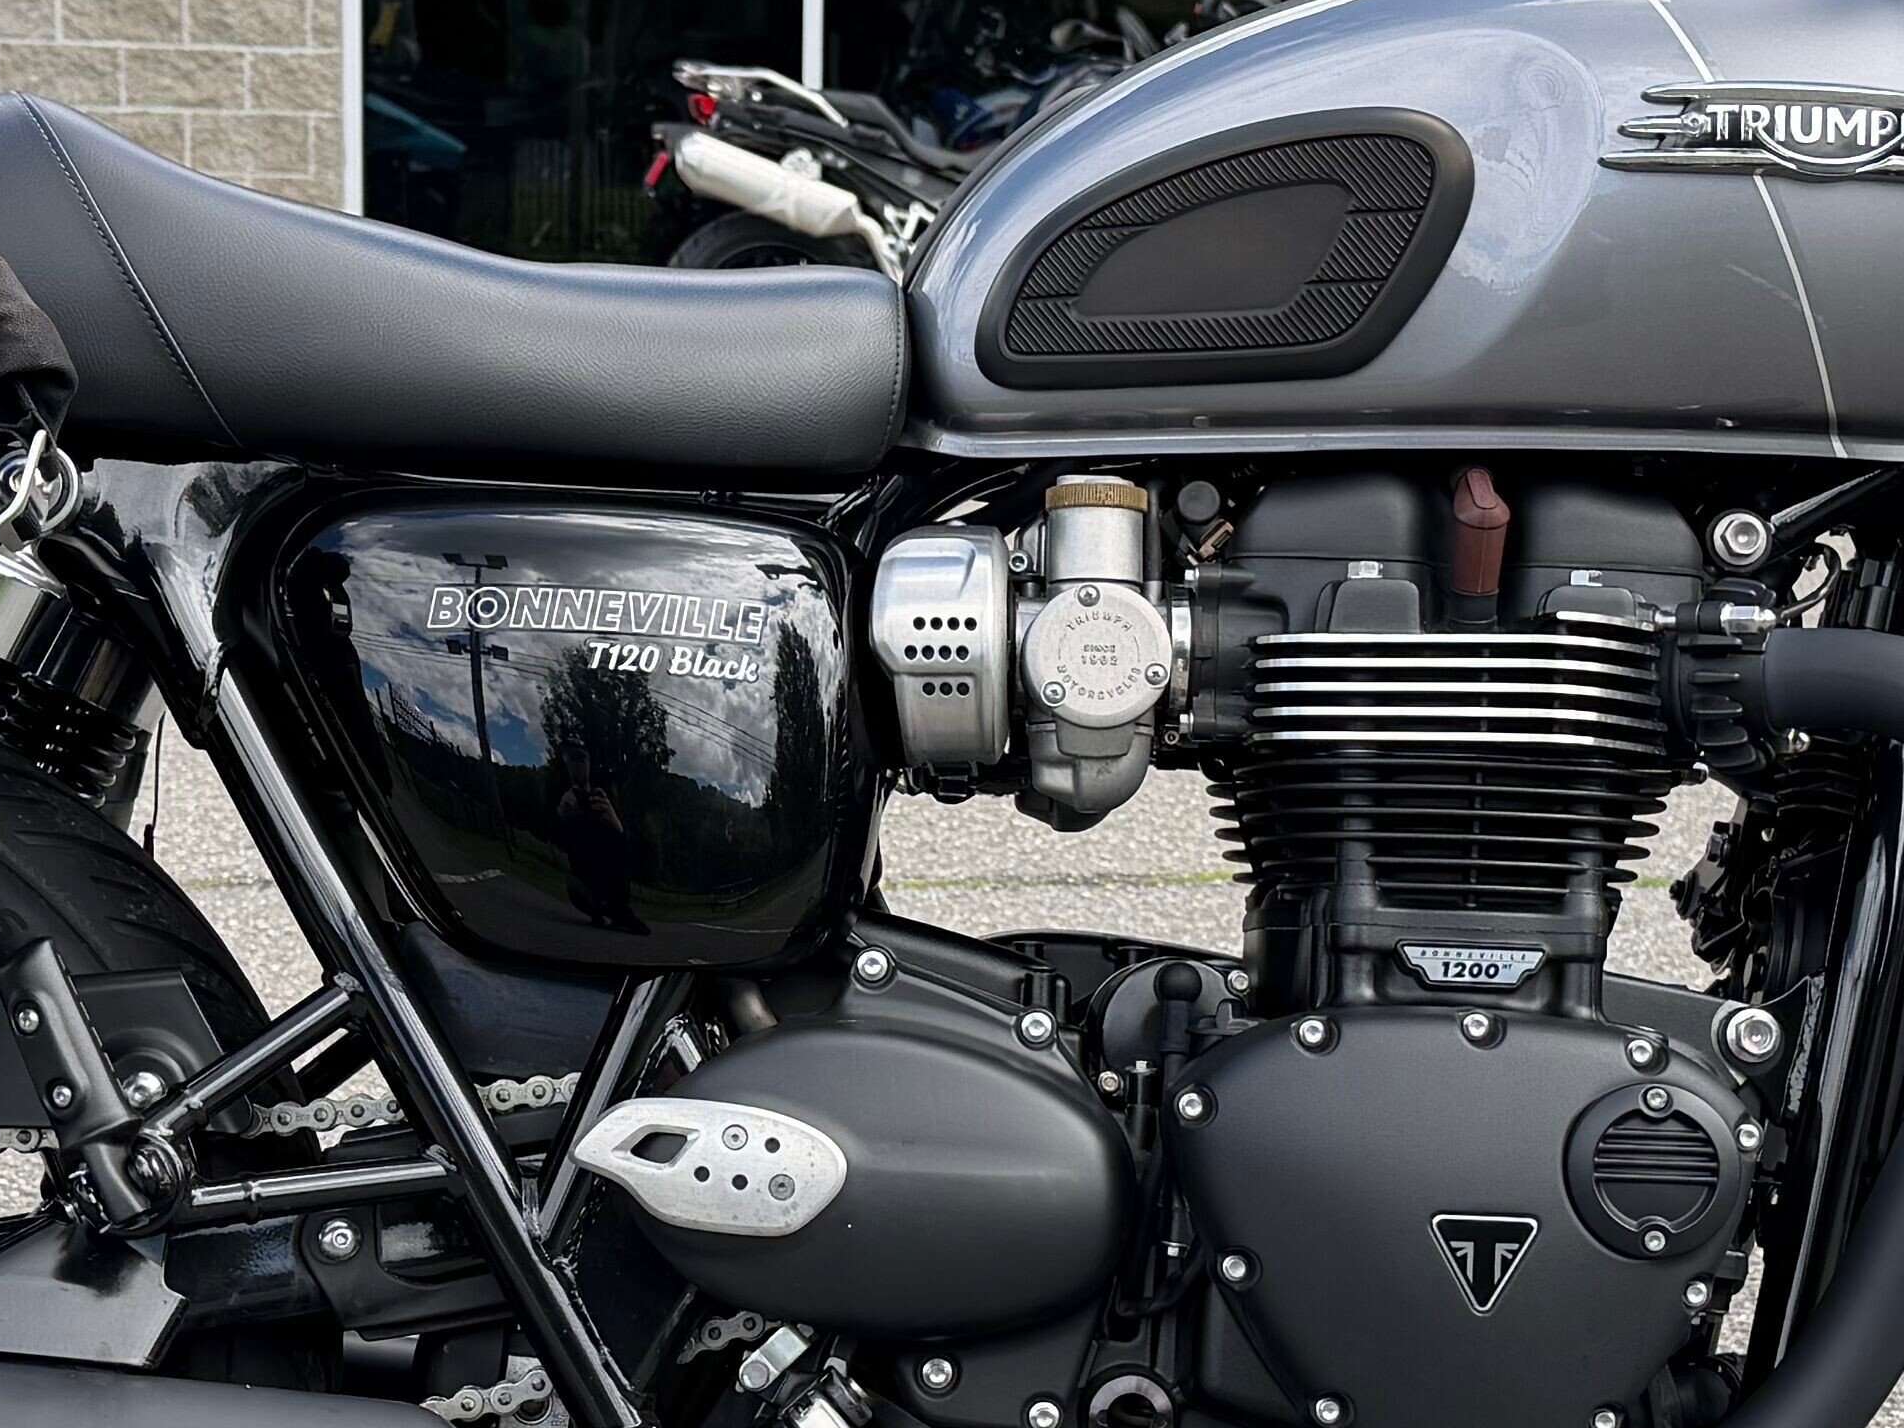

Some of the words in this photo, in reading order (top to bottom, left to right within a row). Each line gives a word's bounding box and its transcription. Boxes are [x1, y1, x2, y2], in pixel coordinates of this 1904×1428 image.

[427, 586, 769, 642] BONNEVILLE
[588, 641, 661, 673] T120
[668, 645, 760, 682] Black
[1420, 949, 1527, 961] BONNEVILLE
[1441, 961, 1500, 980] 1200
